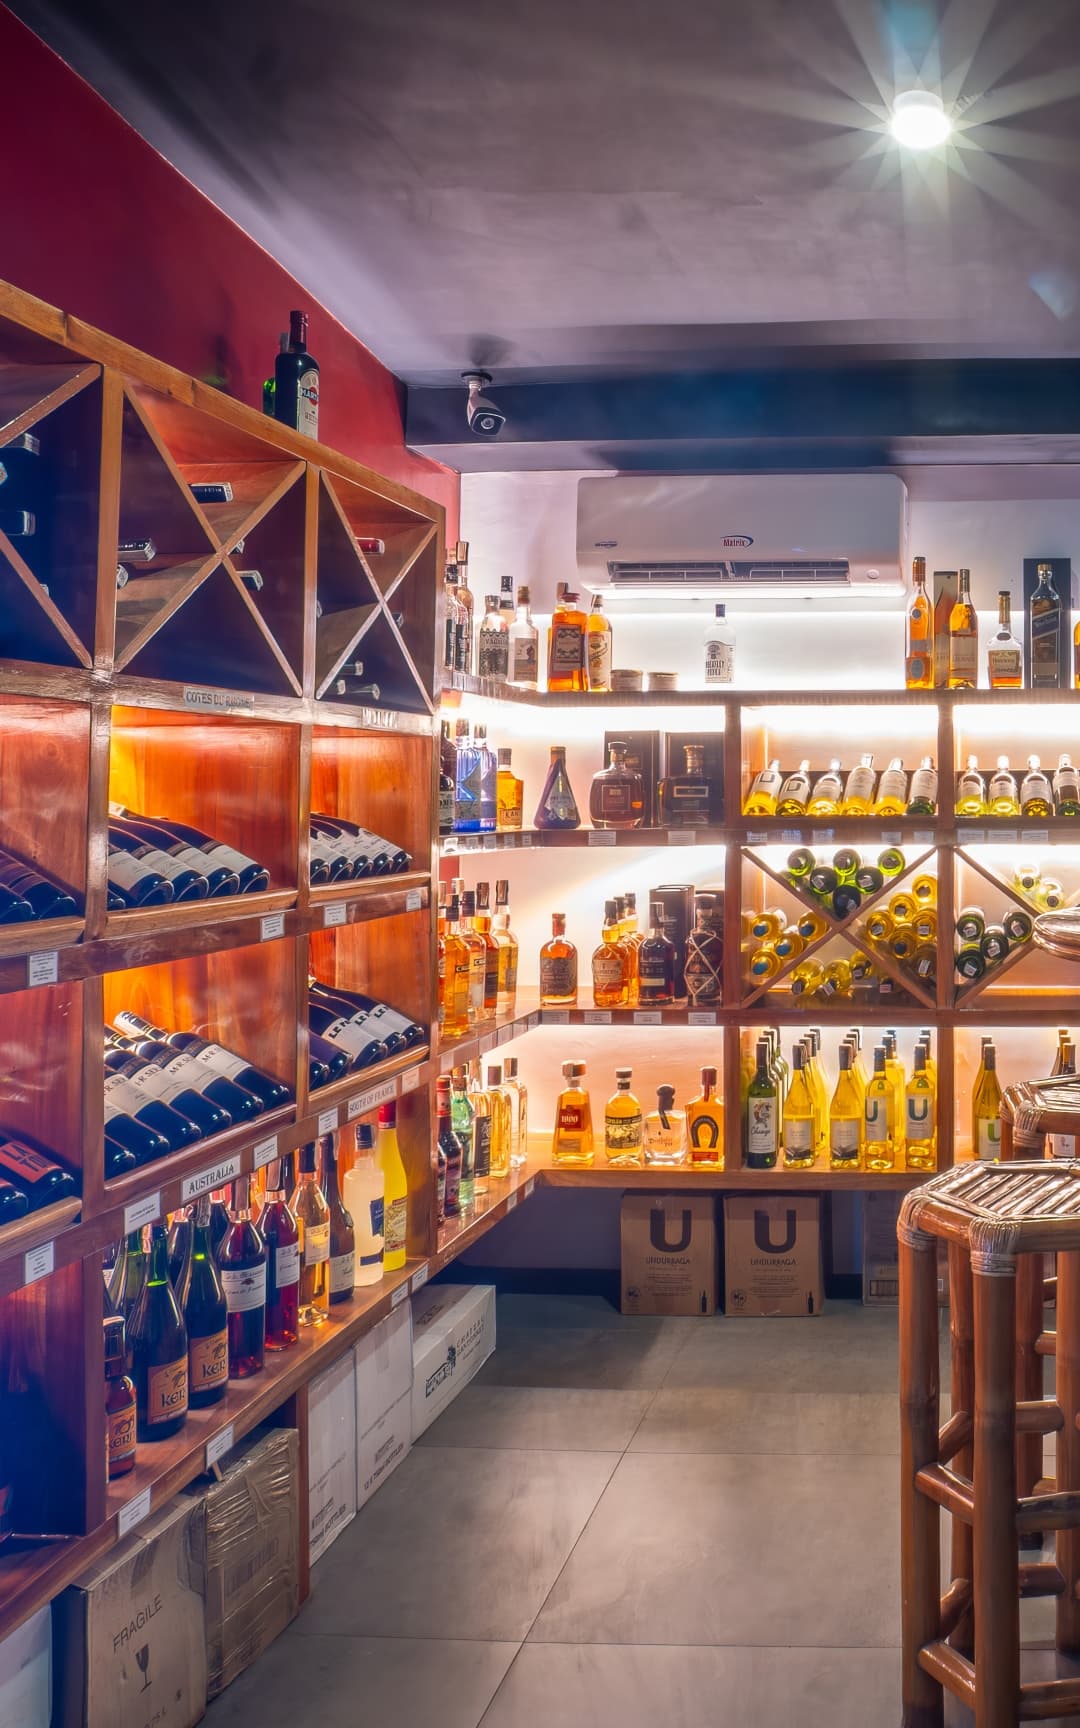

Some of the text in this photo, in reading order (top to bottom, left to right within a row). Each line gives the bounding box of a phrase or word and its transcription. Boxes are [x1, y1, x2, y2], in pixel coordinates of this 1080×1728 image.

[723, 538, 746, 548] Matrix
[908, 1098, 928, 1121] U
[188, 1163, 235, 1195] AUSTRALIA
[650, 1209, 692, 1253] U
[754, 1209, 797, 1254] U
[645, 1256, 691, 1266] UNDURRAGA
[750, 1258, 796, 1267] UNDURRAGA
[112, 1593, 163, 1655] FRAGILE
